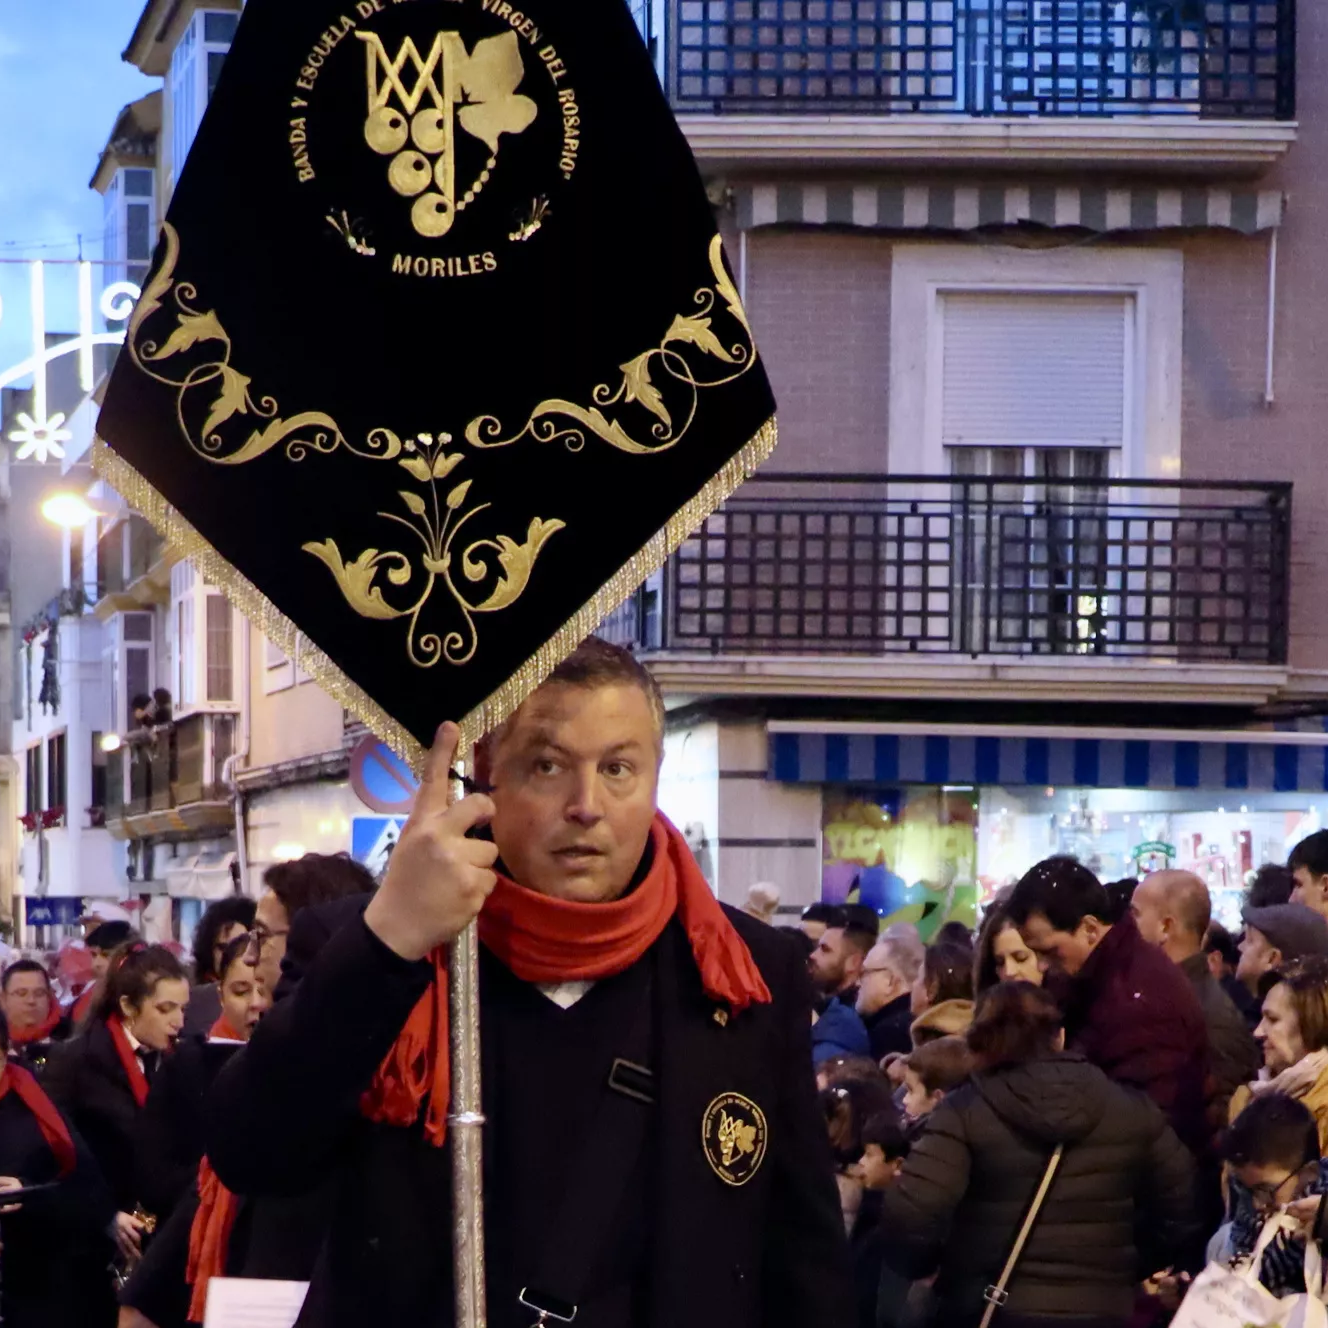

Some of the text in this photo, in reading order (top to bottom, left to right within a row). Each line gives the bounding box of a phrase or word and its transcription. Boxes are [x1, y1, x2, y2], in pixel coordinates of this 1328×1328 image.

[356, 0, 386, 20] DE
[296, 14, 356, 91] ESCUELA
[538, 45, 568, 86] DEL
[291, 96, 308, 108] Y
[289, 117, 315, 183] BANDA
[392, 251, 497, 277] MORILES
